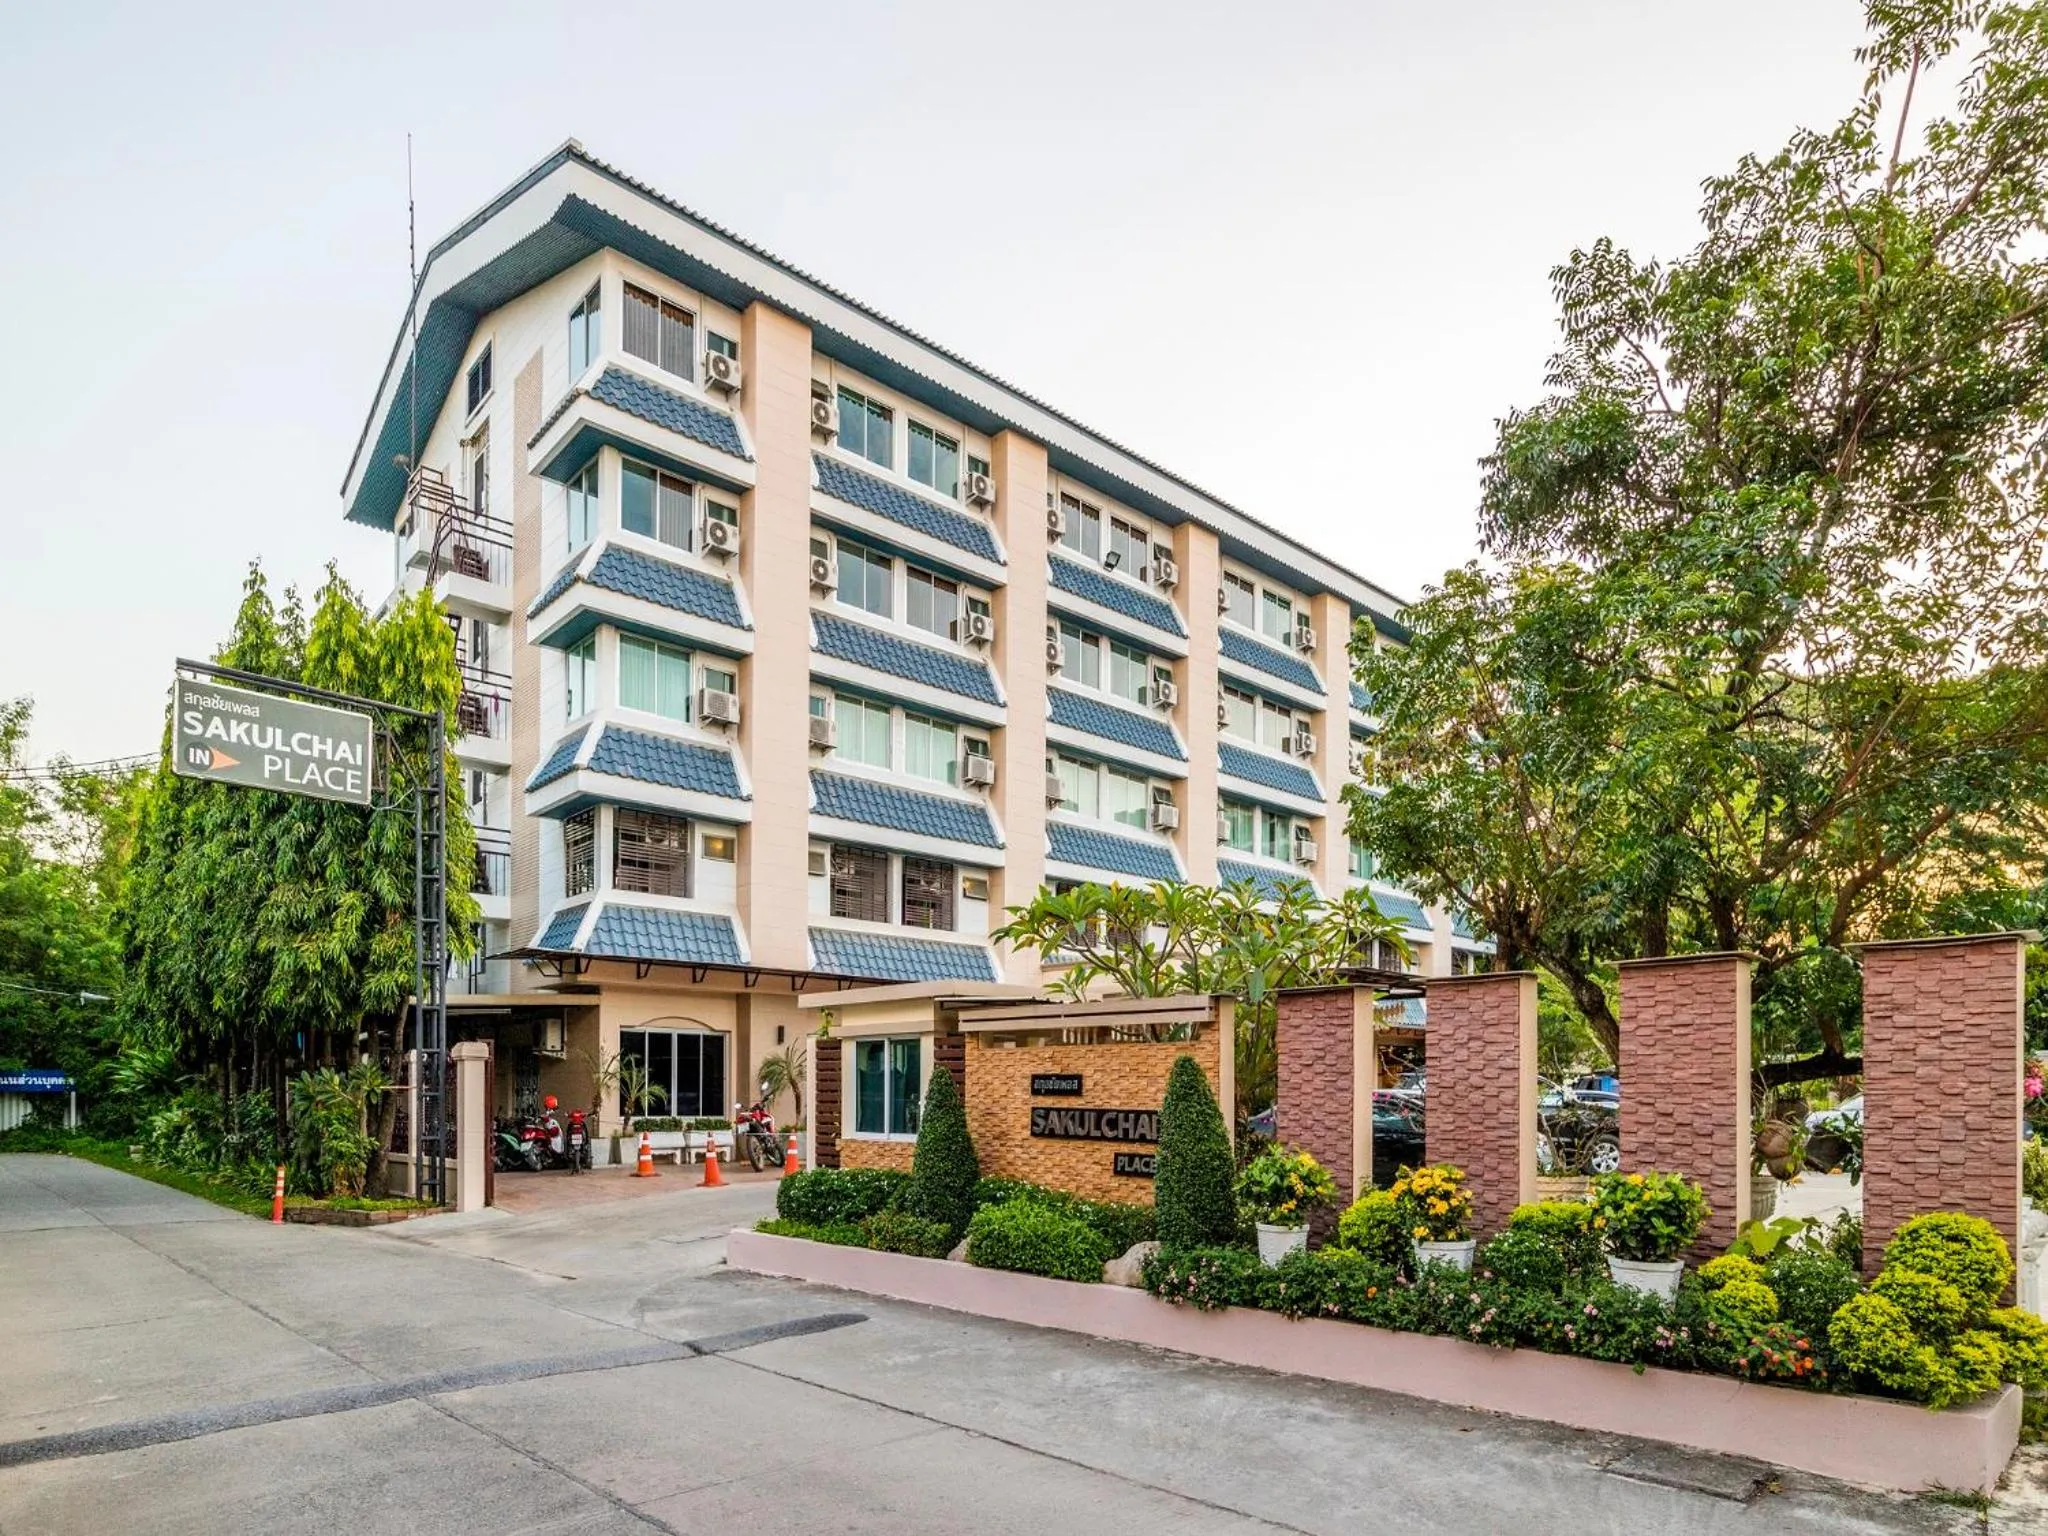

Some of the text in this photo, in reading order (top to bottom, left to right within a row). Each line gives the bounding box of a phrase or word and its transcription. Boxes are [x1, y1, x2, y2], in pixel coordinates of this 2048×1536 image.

[183, 692, 260, 718] สกุลชัยเพลส
[183, 710, 362, 766] SAKULCHAI
[189, 748, 210, 765] IN
[264, 754, 362, 794] PLACE
[1033, 1109, 1158, 1140] SAKULCHAI
[1117, 1156, 1157, 1173] PLACE
